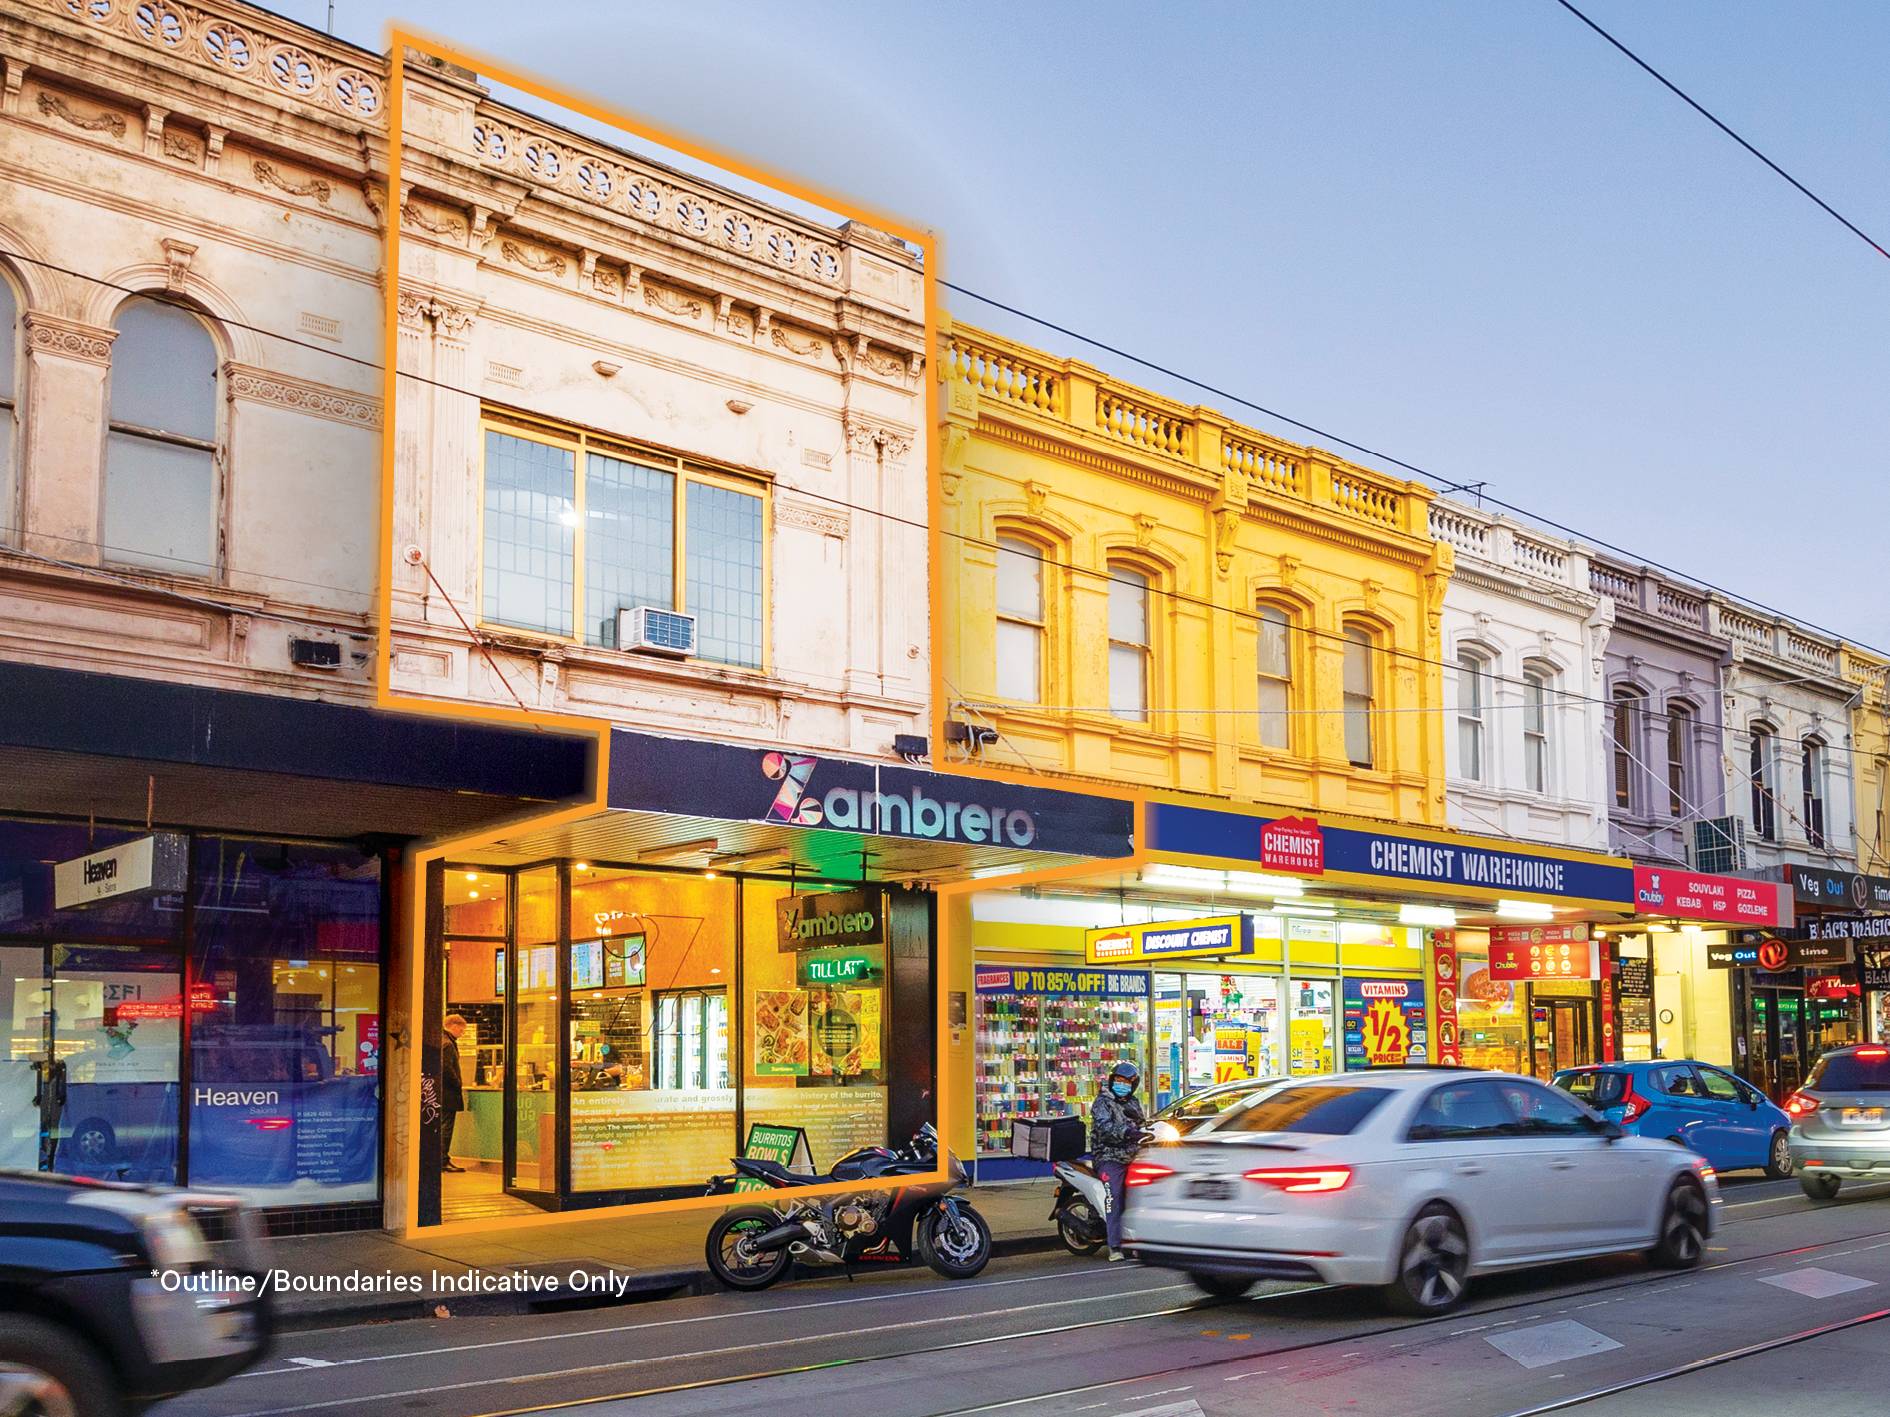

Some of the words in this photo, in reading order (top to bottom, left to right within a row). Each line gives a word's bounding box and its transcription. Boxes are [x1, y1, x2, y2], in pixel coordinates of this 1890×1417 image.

[1264, 832, 1320, 857] CHEMIST
[1264, 853, 1319, 868] WAREHOUSE
[1370, 840, 1455, 878] CHEMIST
[1461, 852, 1564, 891] WAREHOUSE
[84, 858, 117, 885] Heaven
[1688, 882, 1724, 896] SOUVLAKI
[1737, 888, 1756, 900] PIZZA
[1800, 873, 1819, 896] Veg
[1826, 878, 1844, 895] Out
[1874, 884, 1890, 901] tim
[1639, 889, 1665, 906] Chubby
[1676, 896, 1701, 909] KEBAB
[1713, 901, 1727, 912] HSP
[1737, 903, 1768, 916] GOZLEME
[1145, 932, 1190, 950] DISCOUNT
[1190, 928, 1229, 946] CHEMIST
[1711, 952, 1733, 961] Veg
[1735, 951, 1757, 960] Out
[1800, 947, 1829, 957] time
[810, 963, 835, 979] TILL
[837, 960, 865, 977] LAT
[977, 973, 1009, 985] FRAGRANCES
[1013, 971, 1030, 991] UP
[1030, 972, 1046, 991] TO
[1047, 972, 1077, 992] 85%
[1107, 974, 1119, 991] BIG
[1120, 974, 1146, 993] BRANDS
[1363, 984, 1406, 995] VITAMINS
[1370, 1010, 1402, 1052] 1/2
[1373, 1053, 1395, 1063] PRICE
[195, 1087, 279, 1107] Heaven
[573, 1097, 586, 1105] An
[588, 1095, 626, 1106] entirely
[682, 1094, 699, 1103] and
[701, 1092, 733, 1104] grossly
[800, 1092, 828, 1102] history
[830, 1091, 839, 1099] of
[840, 1090, 853, 1099] the
[854, 1090, 883, 1099] burrito.
[751, 1131, 793, 1147] BURRITOS
